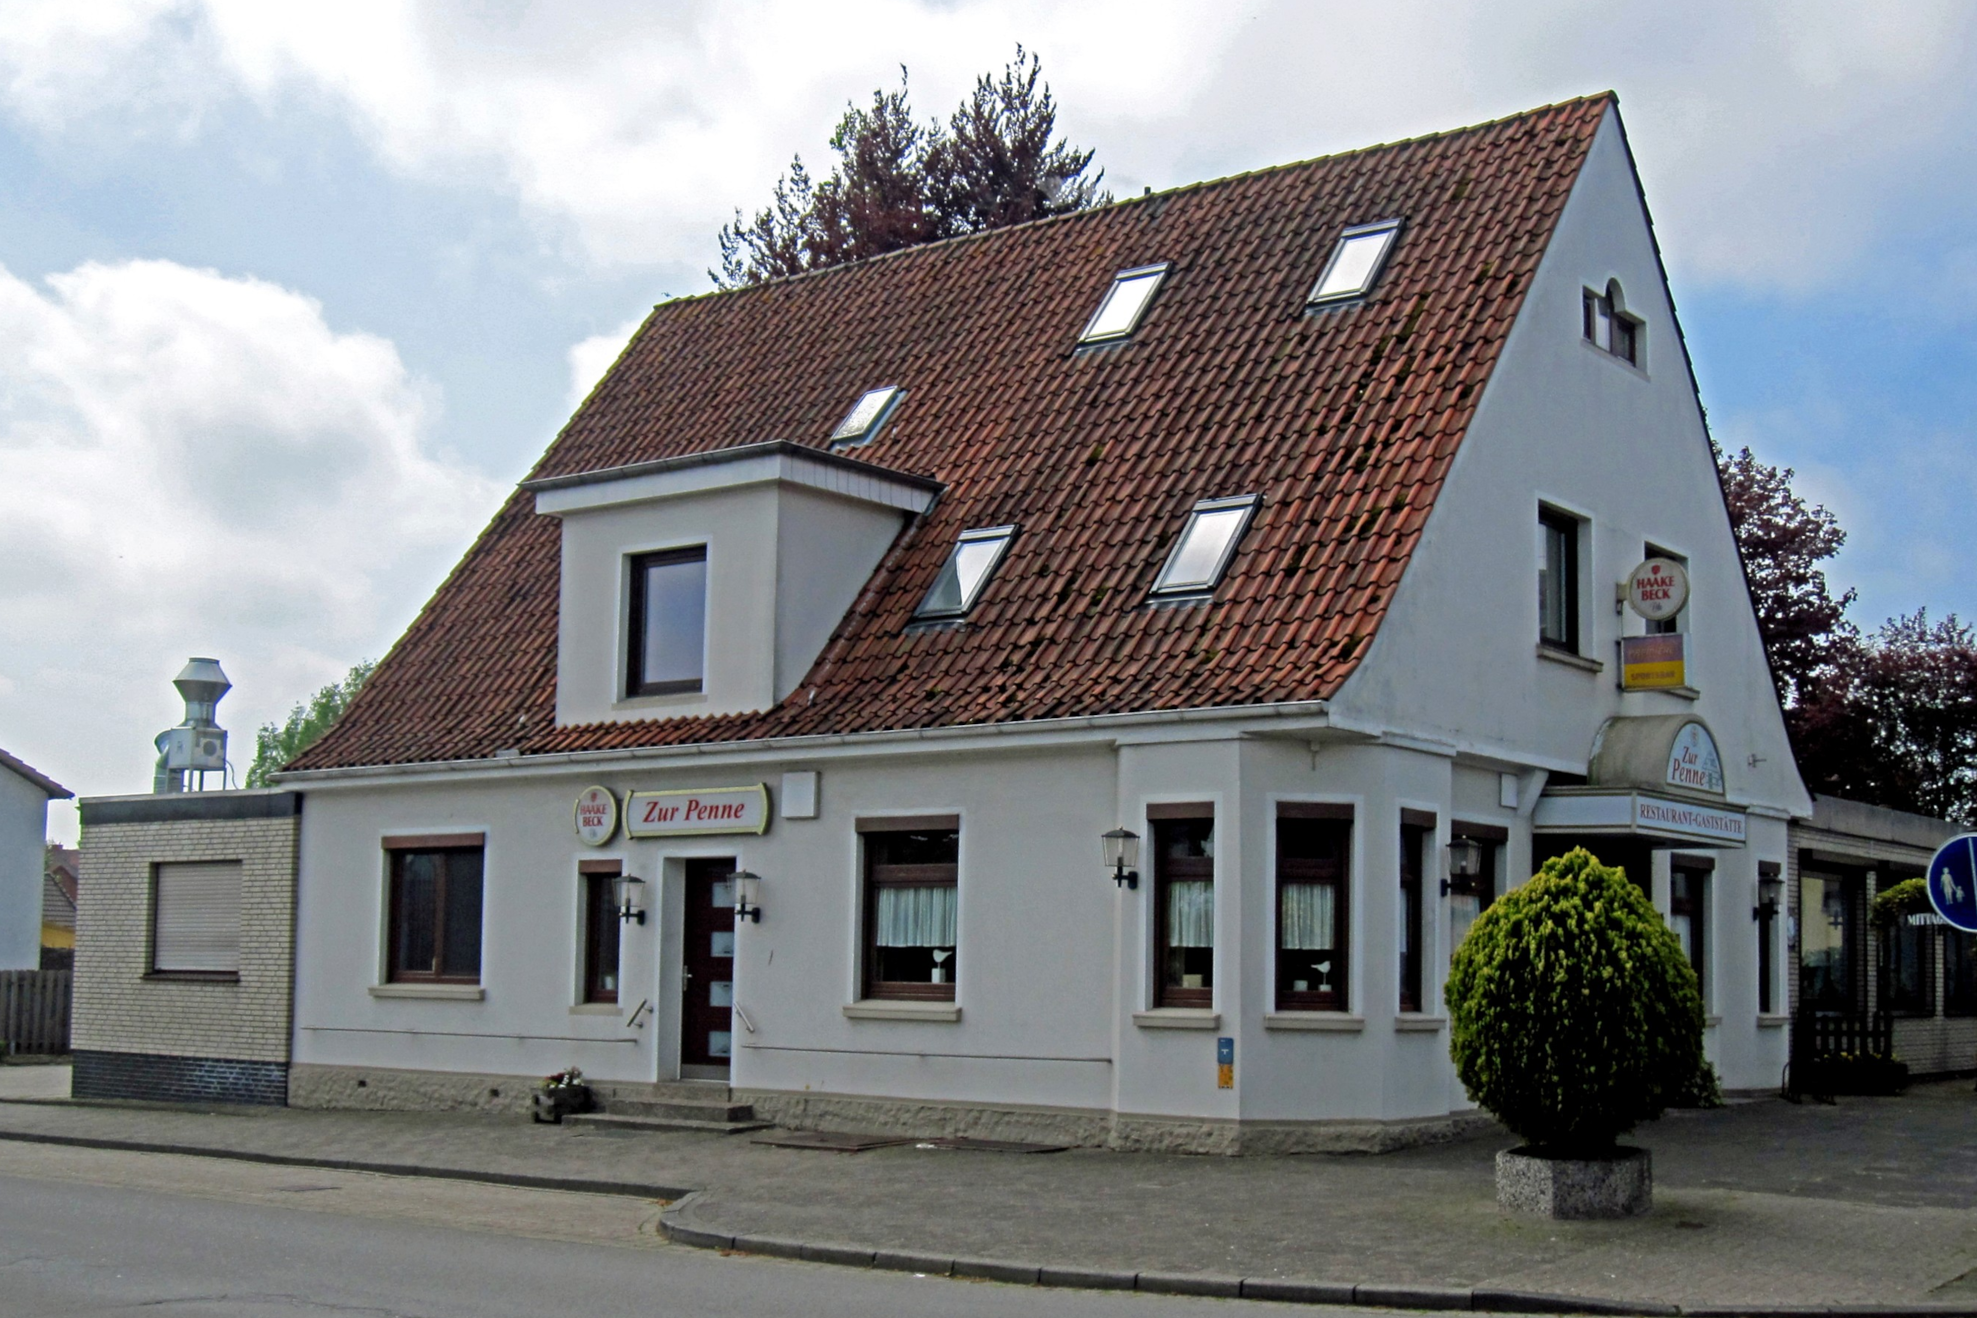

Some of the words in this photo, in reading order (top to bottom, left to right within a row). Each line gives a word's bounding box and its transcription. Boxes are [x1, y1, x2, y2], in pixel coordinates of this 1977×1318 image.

[1636, 575, 1675, 589] HAAKE
[1641, 589, 1671, 601] BECK
[1682, 746, 1698, 765] Zur
[1672, 758, 1706, 787] Penne
[580, 803, 607, 815] HAAKE
[642, 800, 679, 823] Zur
[684, 798, 745, 821] Penne
[582, 815, 603, 827] BECK
[1640, 803, 1742, 834] RESTAURANT-GASTSTÄTTE
